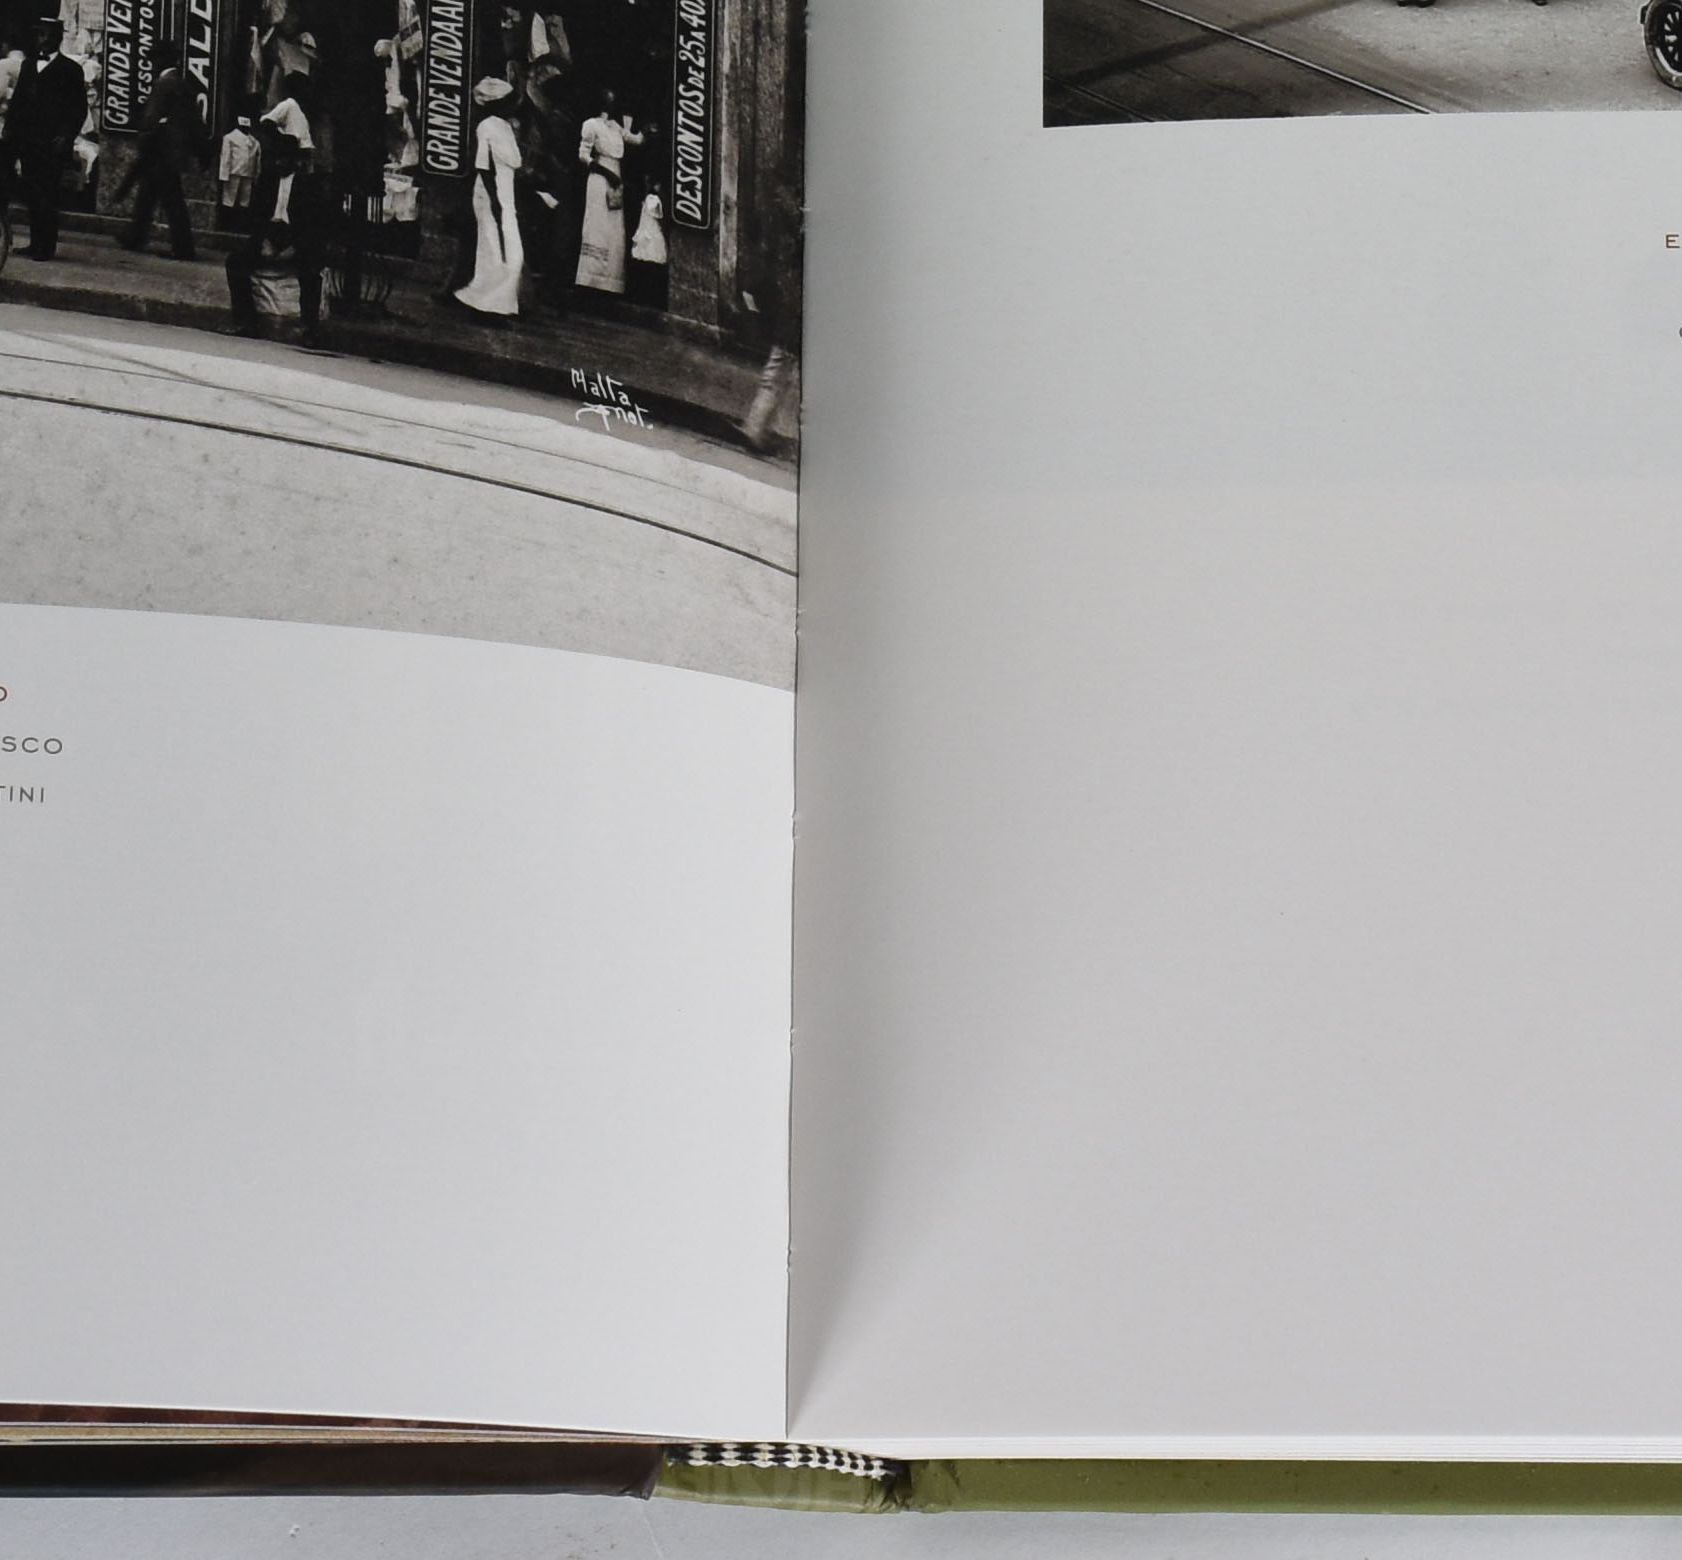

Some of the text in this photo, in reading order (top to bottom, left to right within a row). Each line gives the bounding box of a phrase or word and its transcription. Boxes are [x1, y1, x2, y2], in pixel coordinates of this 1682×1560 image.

[429, 22, 464, 87] VENDA
[678, 34, 707, 69] 25
[689, 31, 707, 43] A
[104, 37, 131, 125] GRANDE
[687, 65, 706, 90] DE
[426, 88, 462, 171] GRANDE
[676, 83, 706, 221] DESCONTOS
[571, 368, 632, 407] Malta
